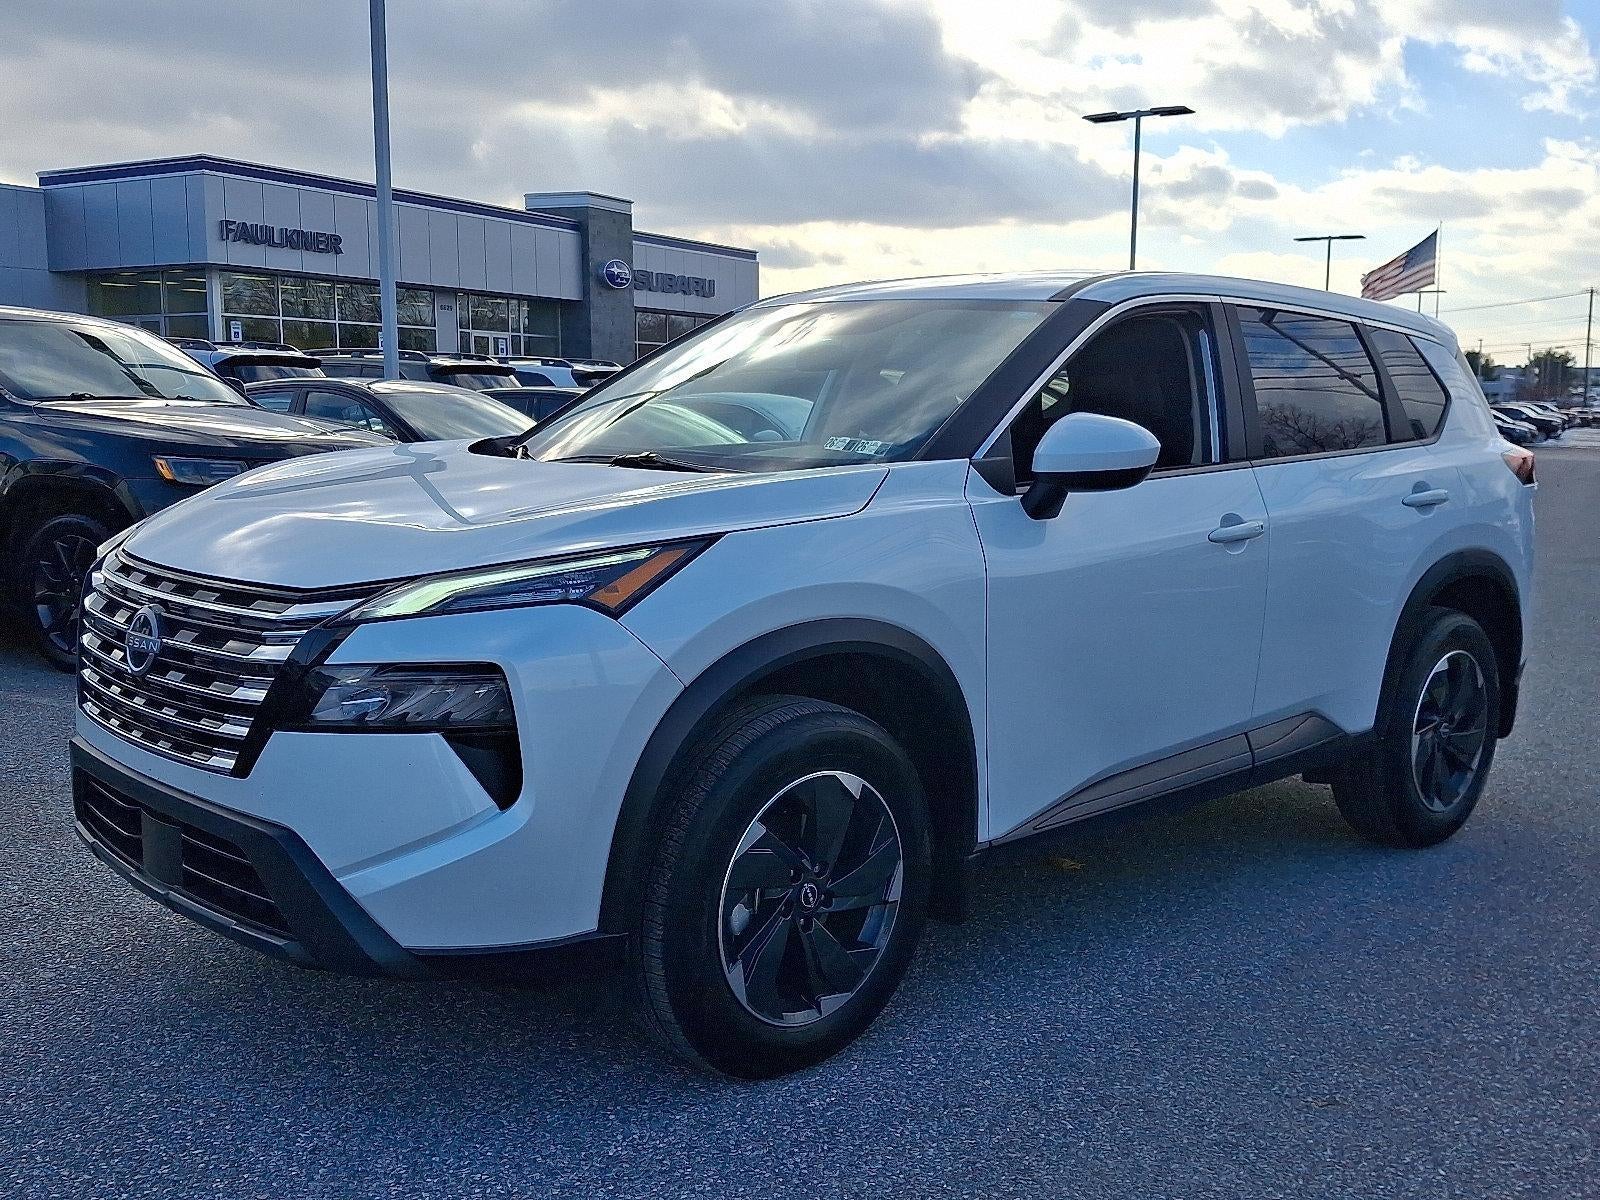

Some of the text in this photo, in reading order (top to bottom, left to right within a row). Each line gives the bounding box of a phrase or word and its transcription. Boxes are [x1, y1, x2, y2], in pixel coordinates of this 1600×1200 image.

[219, 219, 343, 254] FAULKNER
[633, 269, 715, 298] SUBARU
[128, 635, 158, 651] SSAN
